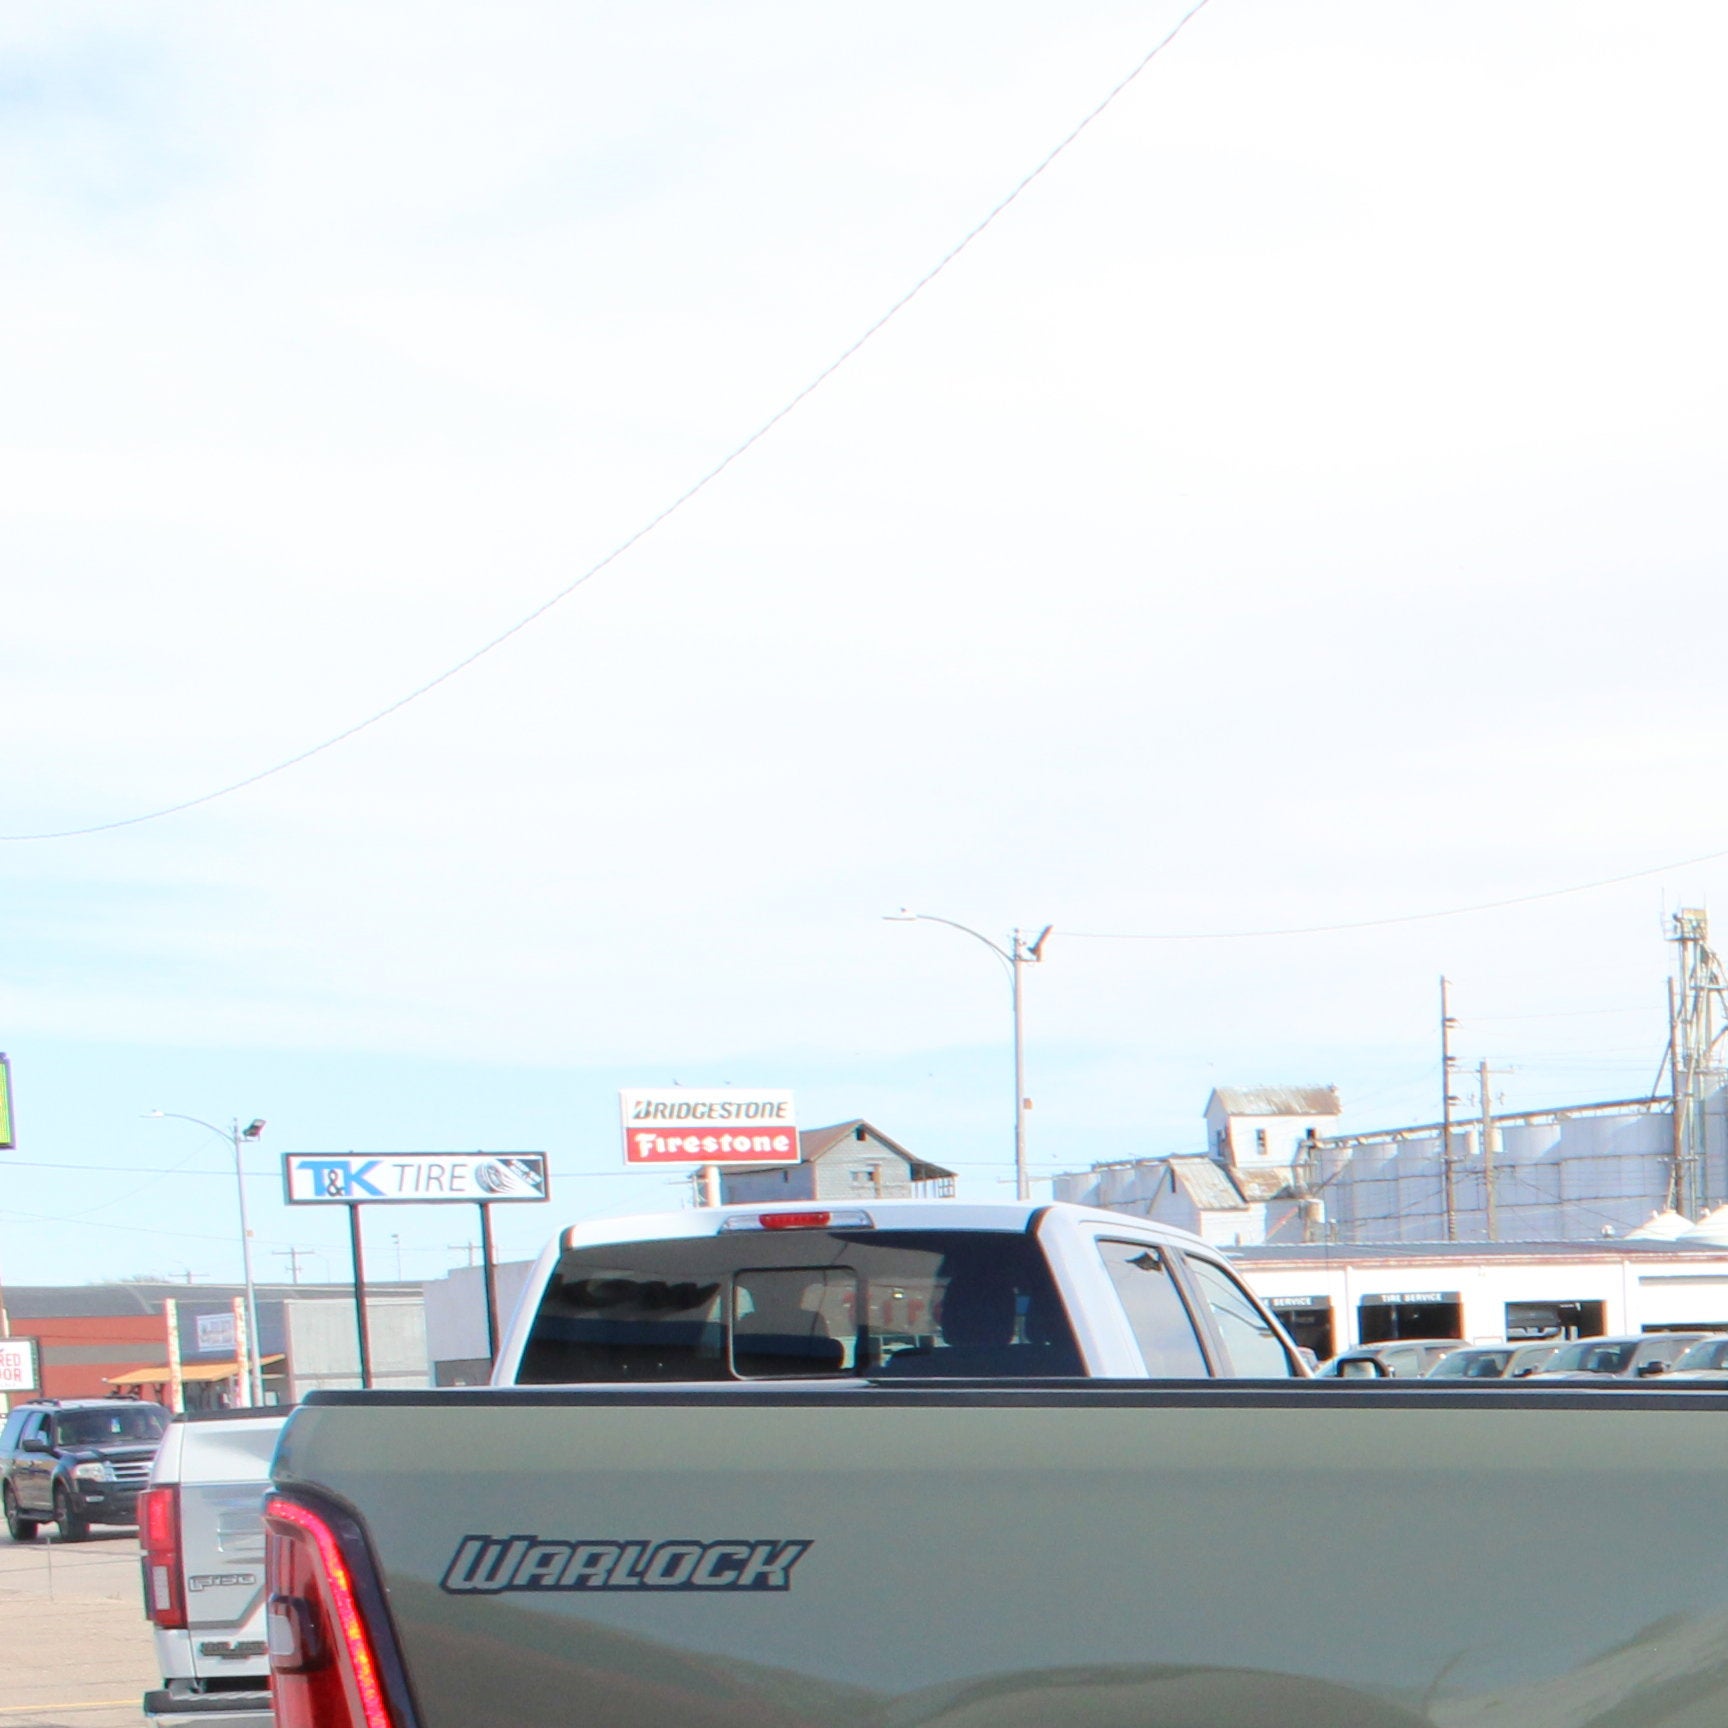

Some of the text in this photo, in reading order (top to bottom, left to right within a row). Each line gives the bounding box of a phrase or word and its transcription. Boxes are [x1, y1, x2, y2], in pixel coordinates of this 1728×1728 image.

[633, 1100, 789, 1120] BRIDGESTONE
[634, 1132, 790, 1158] Firestone
[297, 1160, 387, 1197] T&K
[392, 1163, 468, 1192] TIRE
[1381, 1294, 1401, 1303] TIRE
[440, 1534, 814, 1595] WARLOCK
